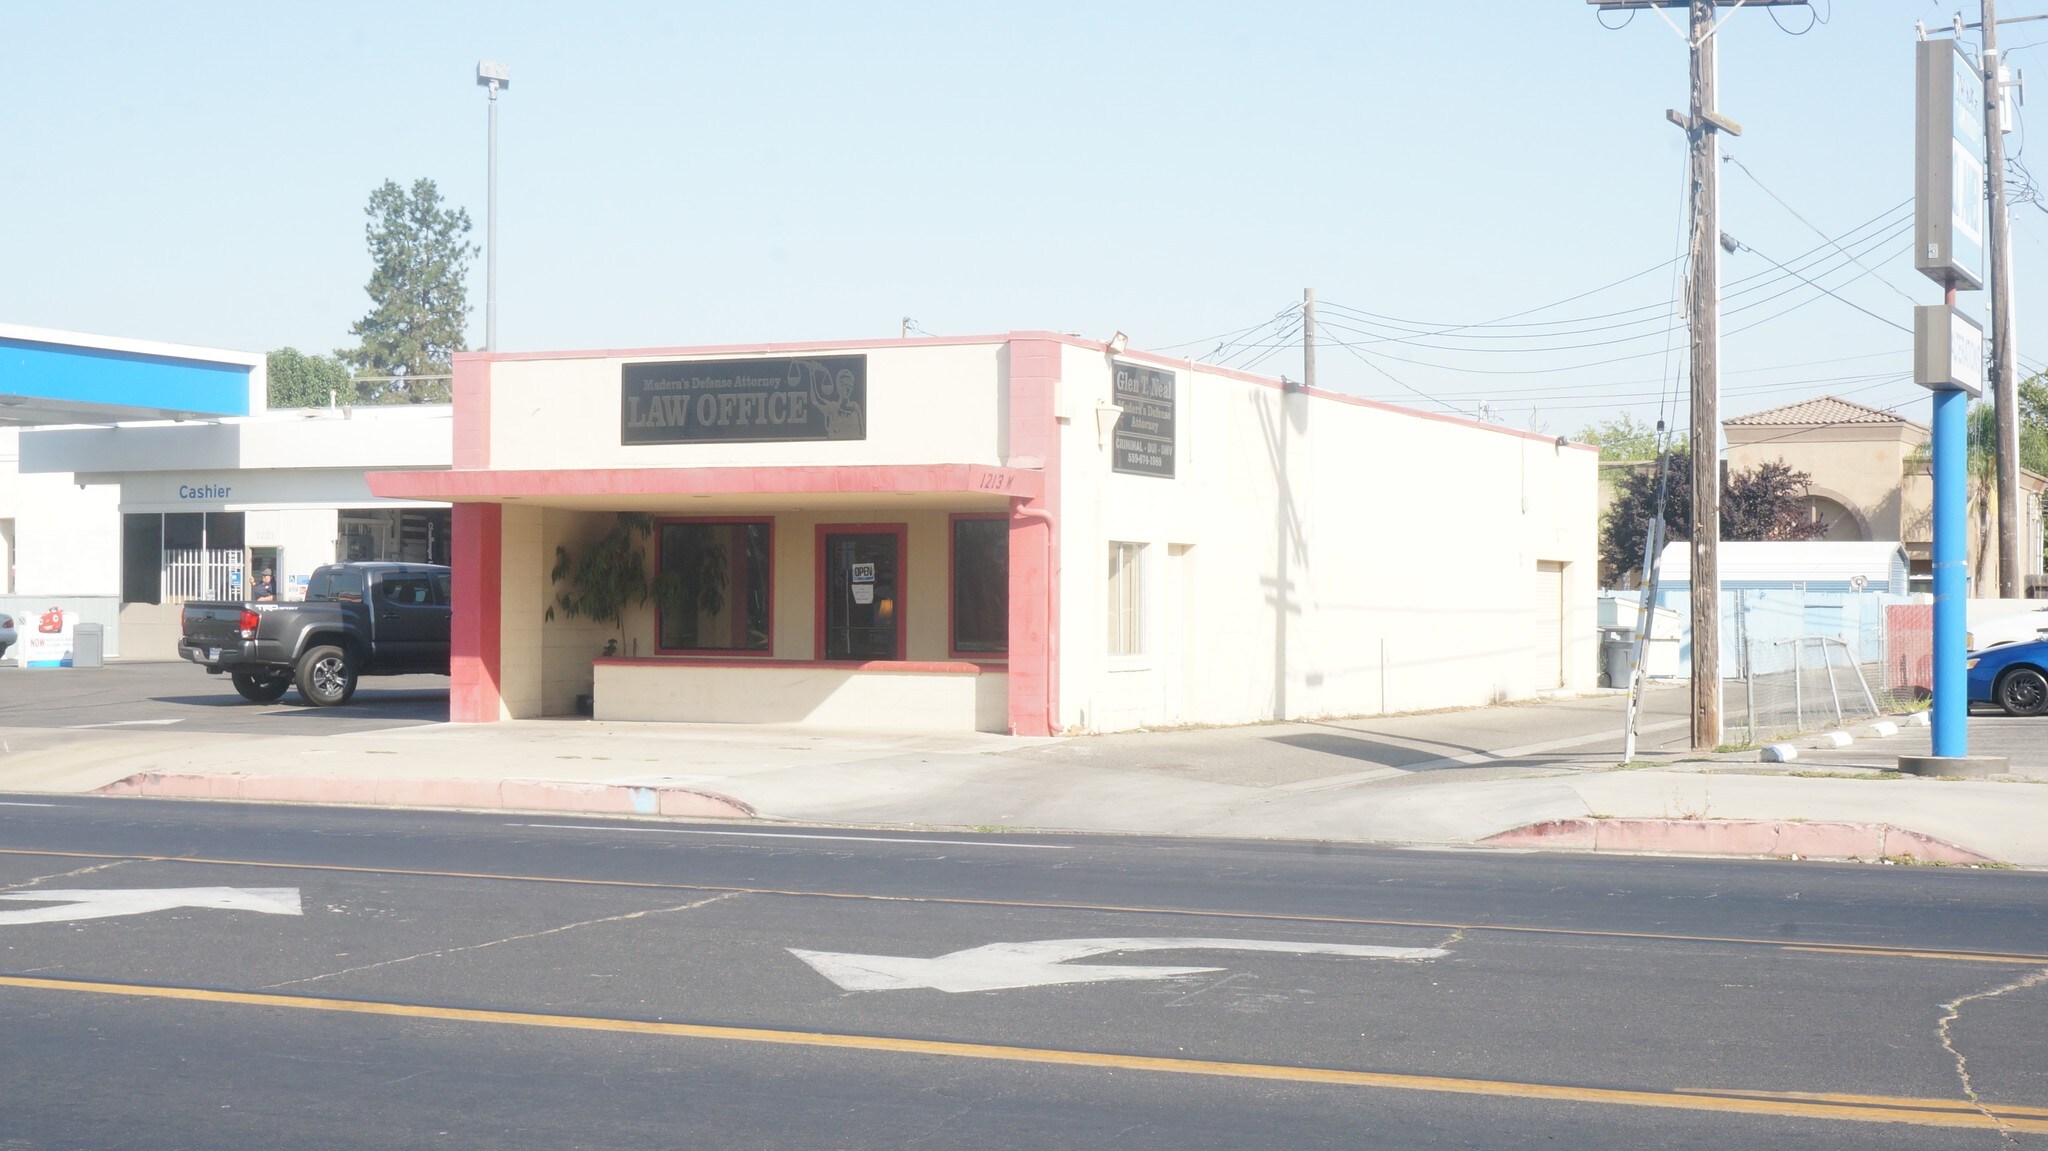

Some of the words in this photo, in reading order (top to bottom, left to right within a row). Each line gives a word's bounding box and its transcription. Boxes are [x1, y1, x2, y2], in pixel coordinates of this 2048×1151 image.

[643, 378, 690, 391] Madera's
[691, 377, 732, 389] Defense
[733, 375, 781, 389] Attorney
[1117, 371, 1139, 393] Glen
[1151, 378, 1172, 399] Neal
[628, 395, 691, 427] LAW
[697, 391, 808, 426] OFFICE
[1131, 416, 1158, 433] Attorney
[1115, 438, 1143, 452] CRIMINAL
[980, 473, 1004, 489] 1213
[179, 484, 232, 499] Cashier
[256, 531, 274, 541] 1221
[854, 566, 873, 577] OPEN
[255, 604, 279, 612] TRD
[30, 637, 45, 648] NOW
